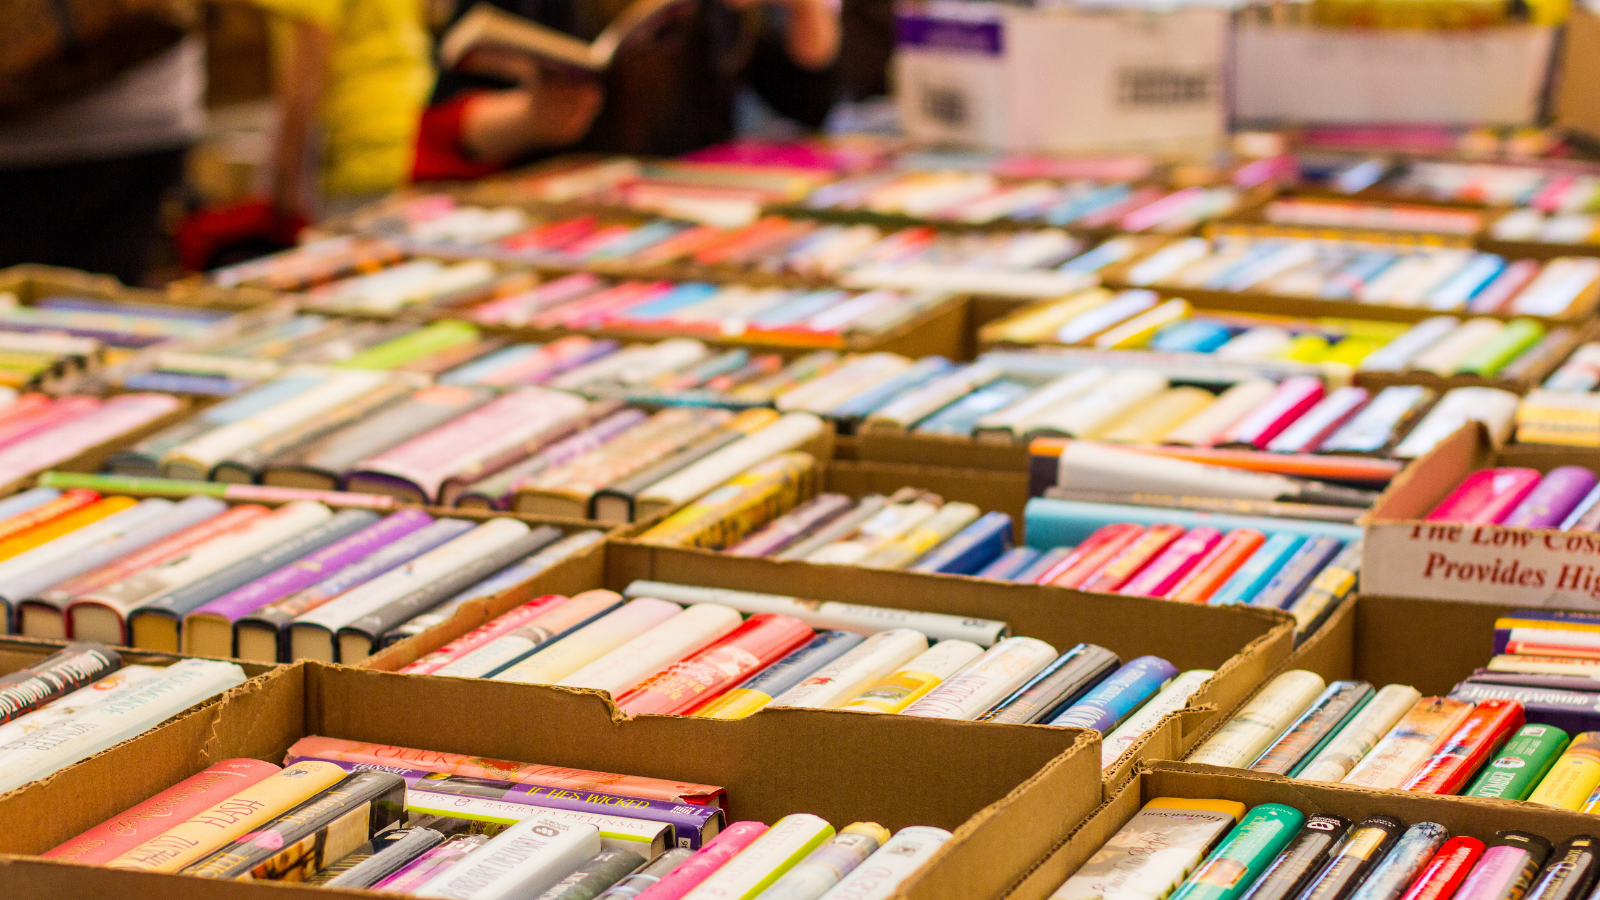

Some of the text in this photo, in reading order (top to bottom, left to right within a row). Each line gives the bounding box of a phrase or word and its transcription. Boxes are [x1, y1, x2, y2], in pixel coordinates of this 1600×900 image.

[1470, 525, 1533, 547] Low
[1422, 551, 1547, 587] Provides
[374, 745, 451, 767] QUICK
[278, 789, 353, 826] Betrayal
[525, 786, 546, 797] IF
[584, 792, 651, 810] WICKED
[188, 798, 266, 829] FLASH
[483, 801, 557, 817] BARBARA
[563, 813, 651, 831] DELINSKY
